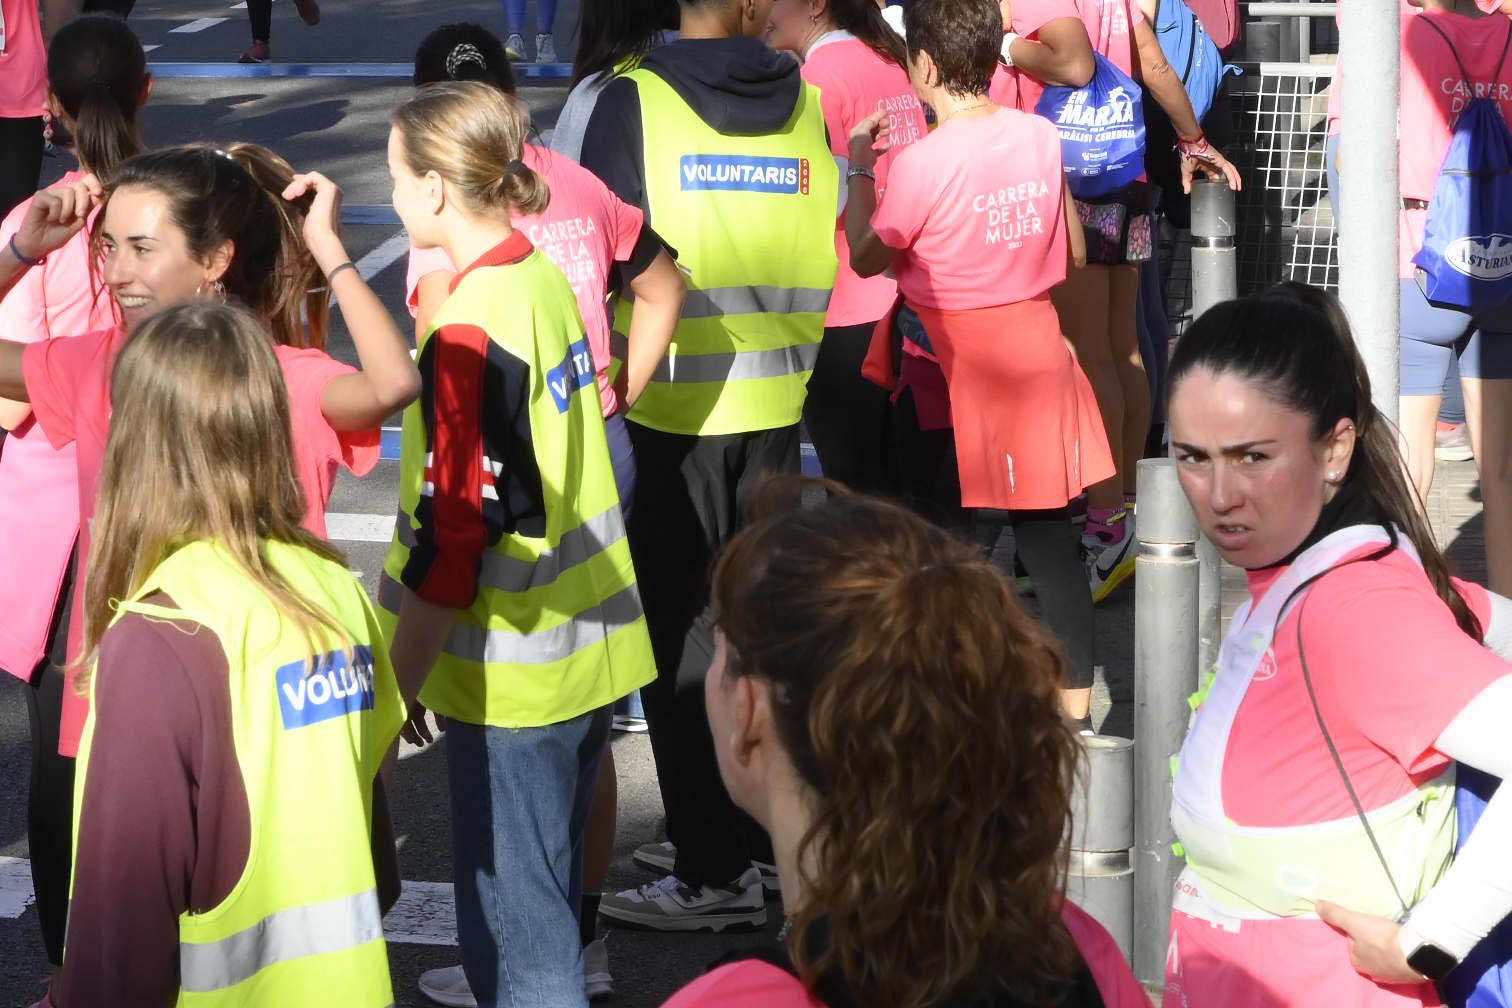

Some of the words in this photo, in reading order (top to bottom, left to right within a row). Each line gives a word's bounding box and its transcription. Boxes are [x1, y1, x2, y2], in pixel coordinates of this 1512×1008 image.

[1057, 101, 1134, 127] MARXA
[683, 162, 798, 187] VOLUNTARIS
[972, 180, 1049, 213] CARRERA
[988, 207, 1012, 229] DE
[1016, 201, 1037, 221] LA
[529, 215, 597, 246] CARRERA
[985, 217, 1044, 246] MUJER
